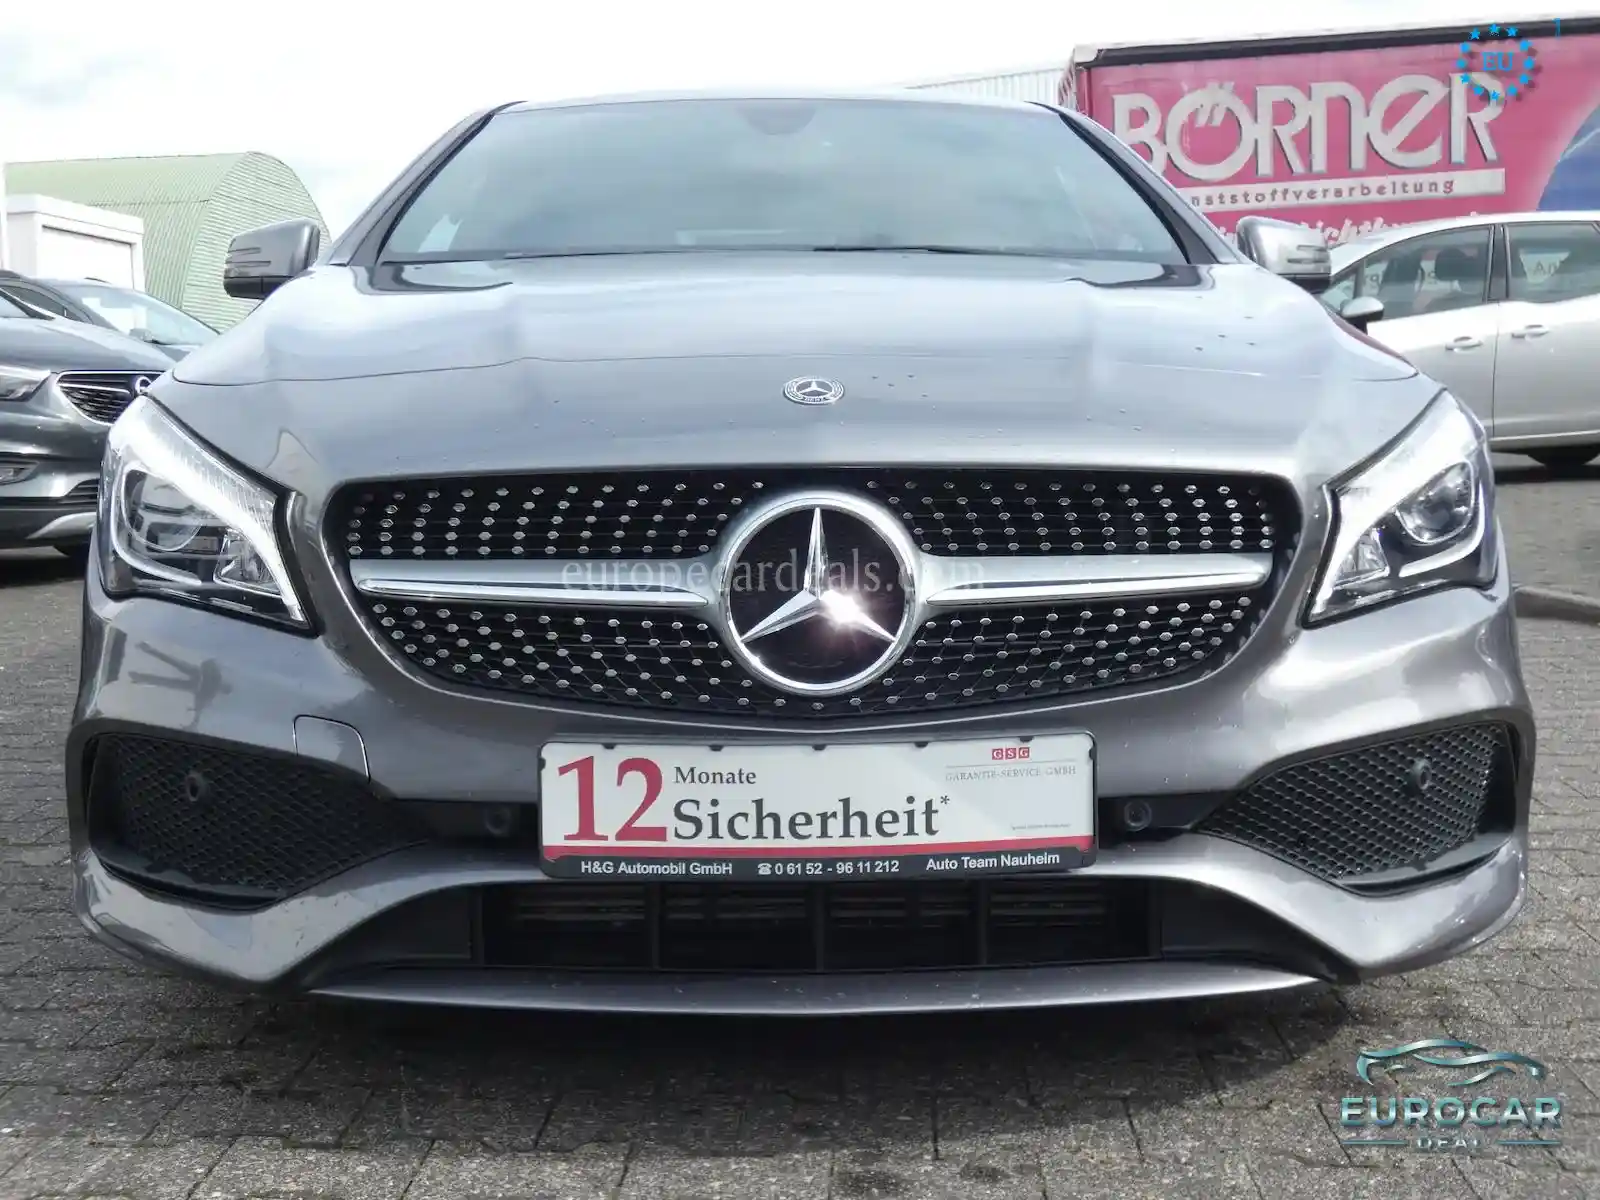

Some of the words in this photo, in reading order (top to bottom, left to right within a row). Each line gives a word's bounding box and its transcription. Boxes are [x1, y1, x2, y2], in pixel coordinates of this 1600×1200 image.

[1190, 178, 1455, 207] nststoffverarbeitung
[992, 747, 1030, 760] GSG
[673, 766, 757, 785] Monate
[557, 755, 668, 842] 12
[580, 860, 614, 874] H&G
[617, 861, 686, 875] Automobil
[689, 862, 733, 875] GmbH
[805, 862, 823, 875] 52
[926, 858, 959, 871] Auto
[961, 856, 998, 869] Team
[1000, 852, 1061, 867] Nauheim
